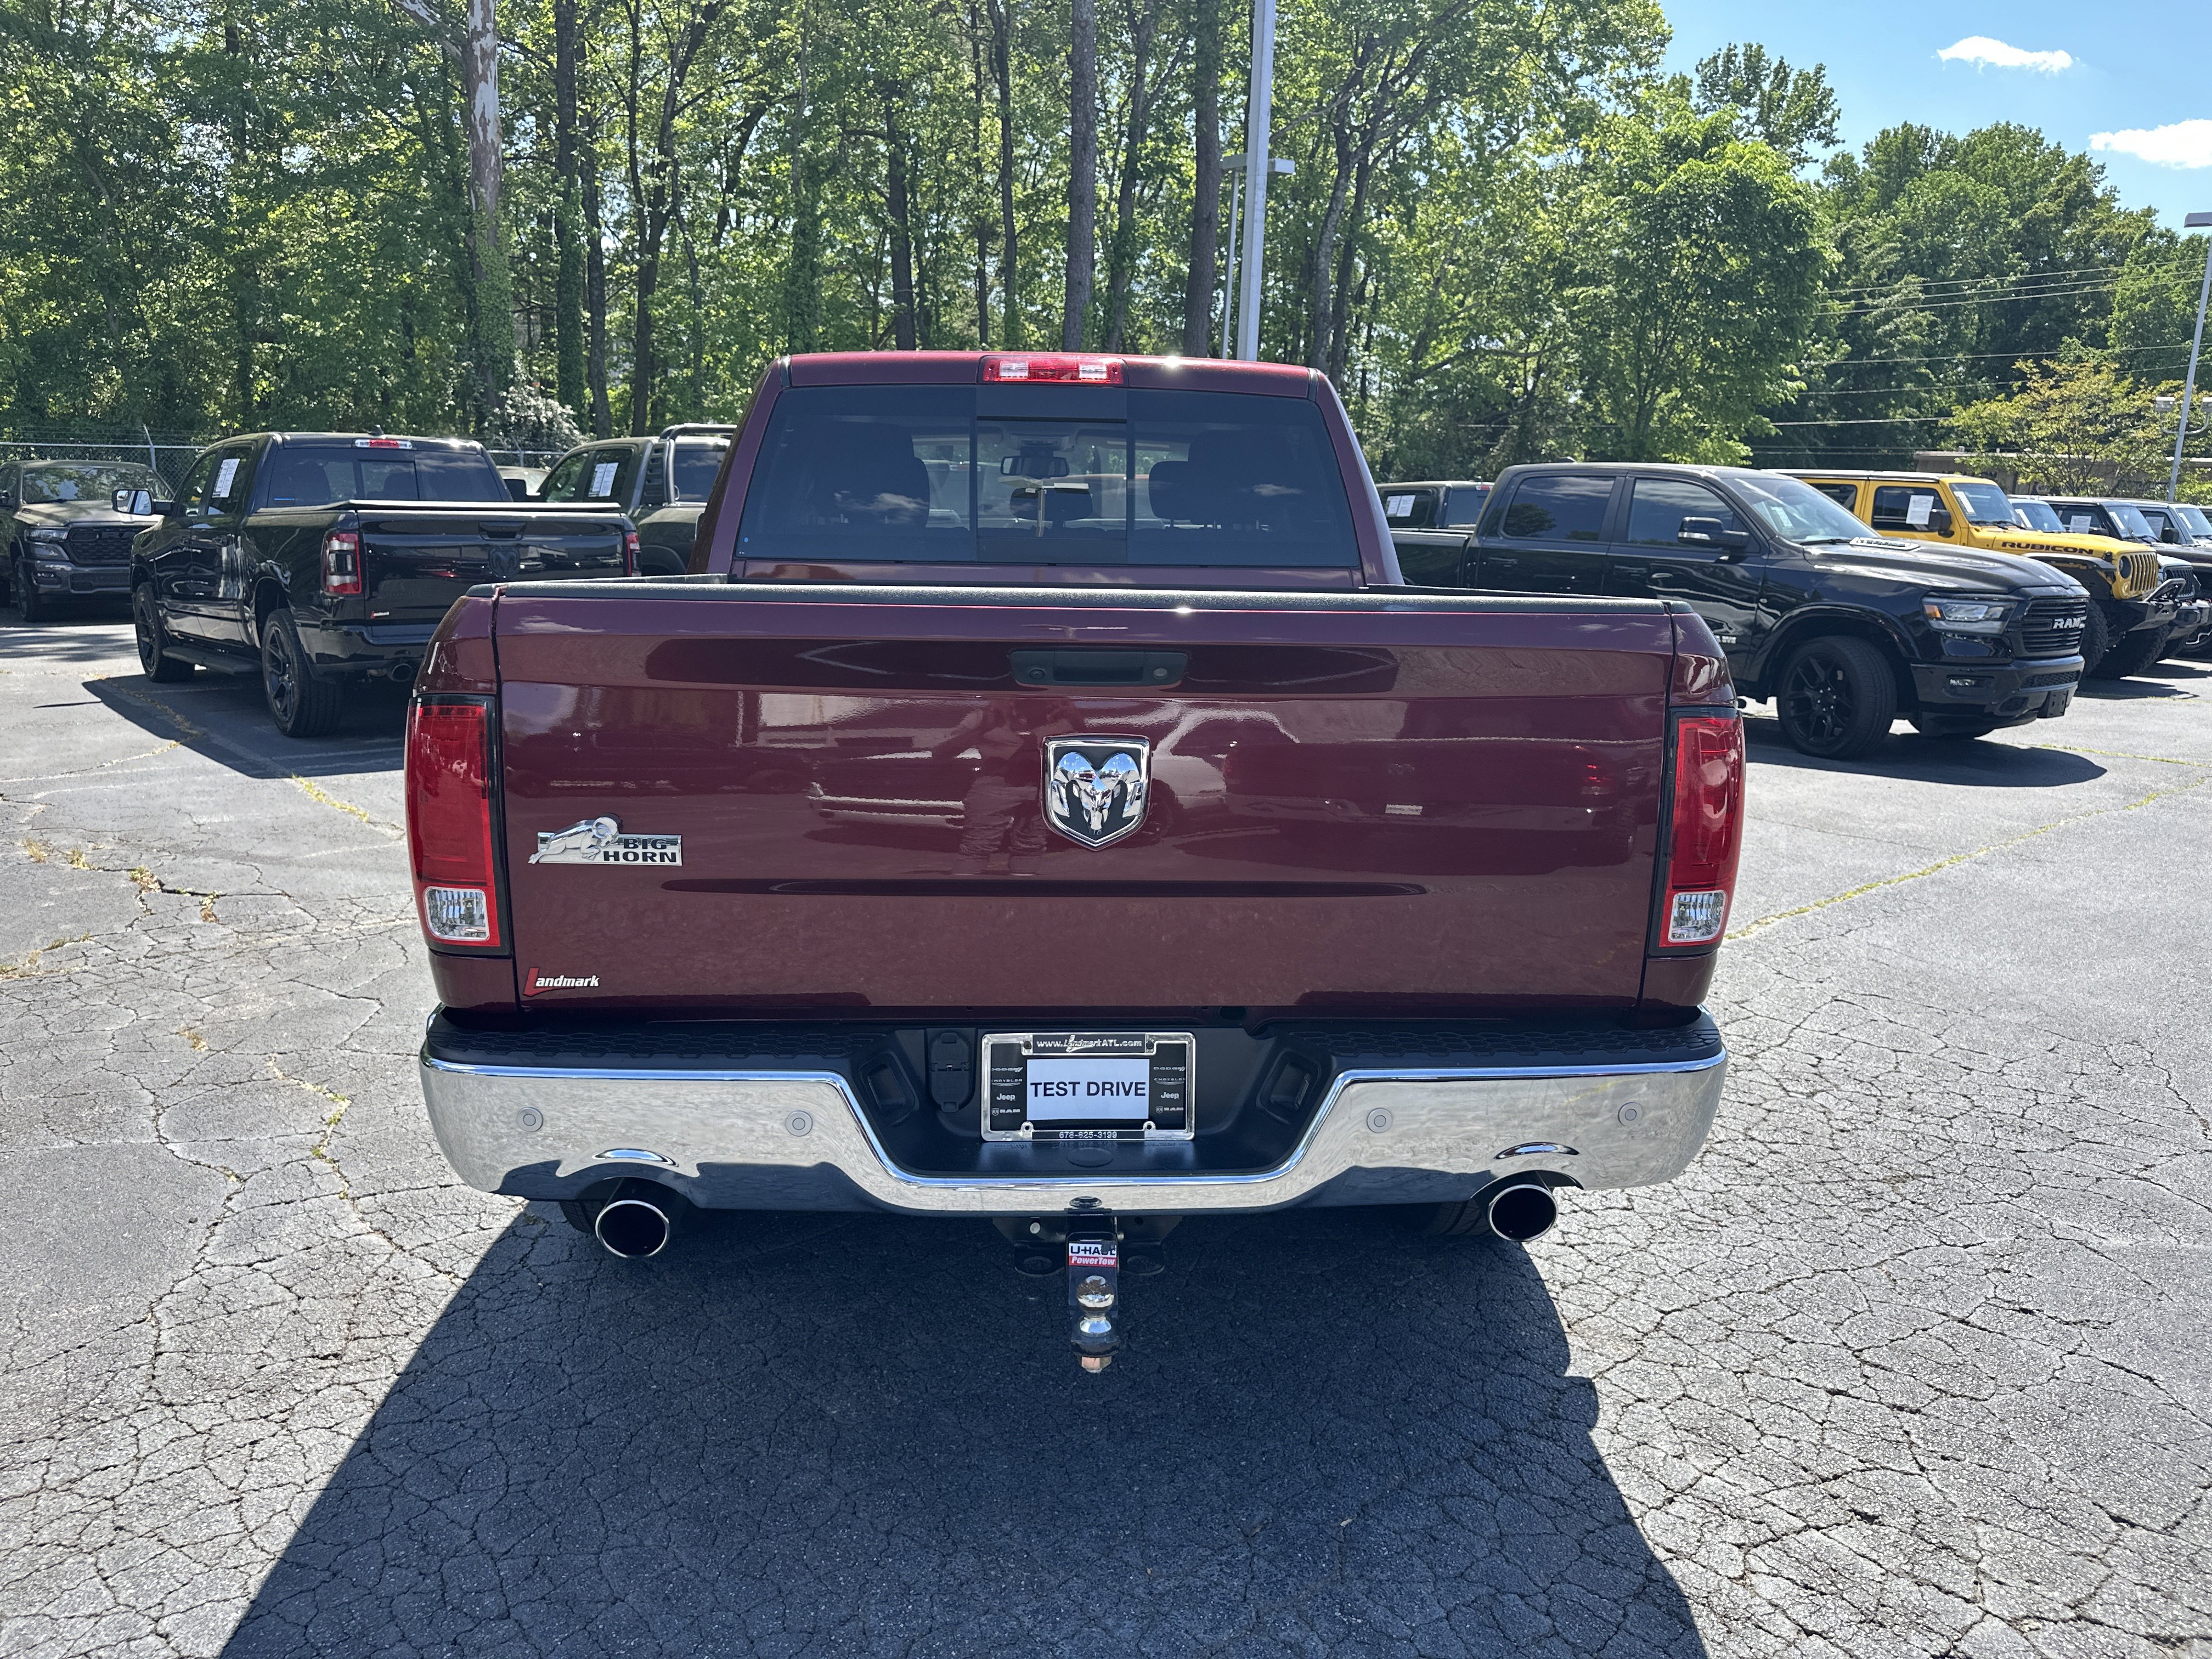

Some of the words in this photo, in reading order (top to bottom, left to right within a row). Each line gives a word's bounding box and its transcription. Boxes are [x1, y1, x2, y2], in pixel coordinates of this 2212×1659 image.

[2001, 541, 2094, 554] RUBICON
[2052, 617, 2081, 629] RAM
[623, 838, 667, 850] BIG
[603, 851, 676, 862] HORN
[523, 967, 600, 997] Landmark
[1030, 1081, 1080, 1097] TEST
[1087, 1081, 1146, 1096] DRIVE
[1071, 1256, 1115, 1265] PowerTow
